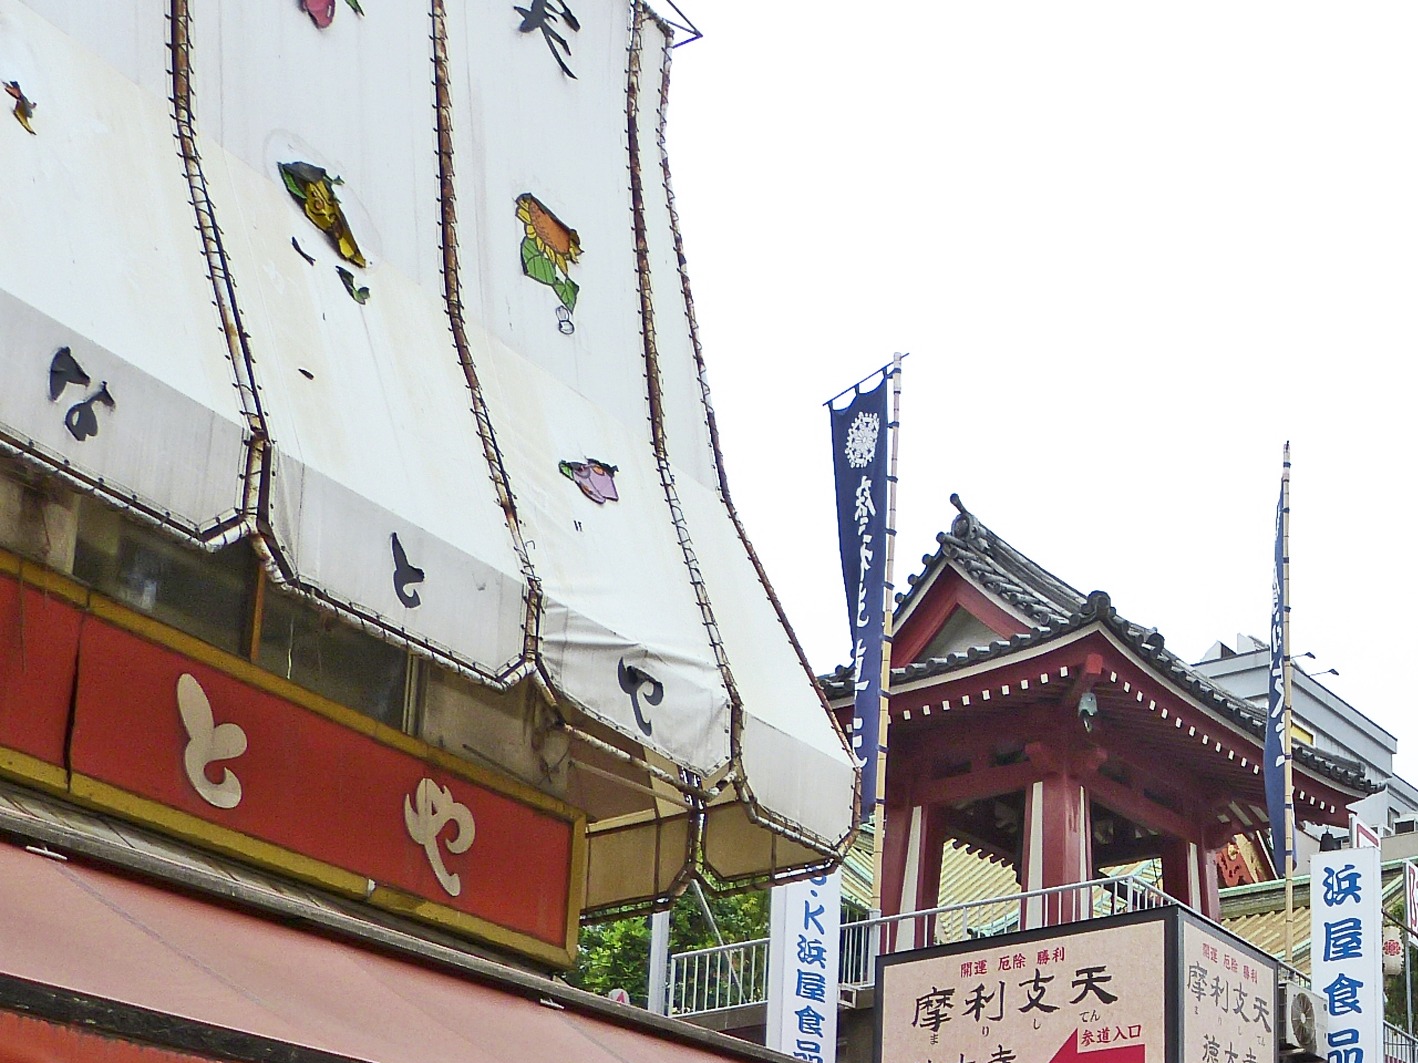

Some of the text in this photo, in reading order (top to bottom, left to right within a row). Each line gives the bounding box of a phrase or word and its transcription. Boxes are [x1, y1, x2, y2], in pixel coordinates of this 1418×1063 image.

[960, 946, 1066, 978] 開運 厄除 勝利
[911, 964, 1119, 1033] 摩利支天
[1080, 1024, 1143, 1046] 参道入口
